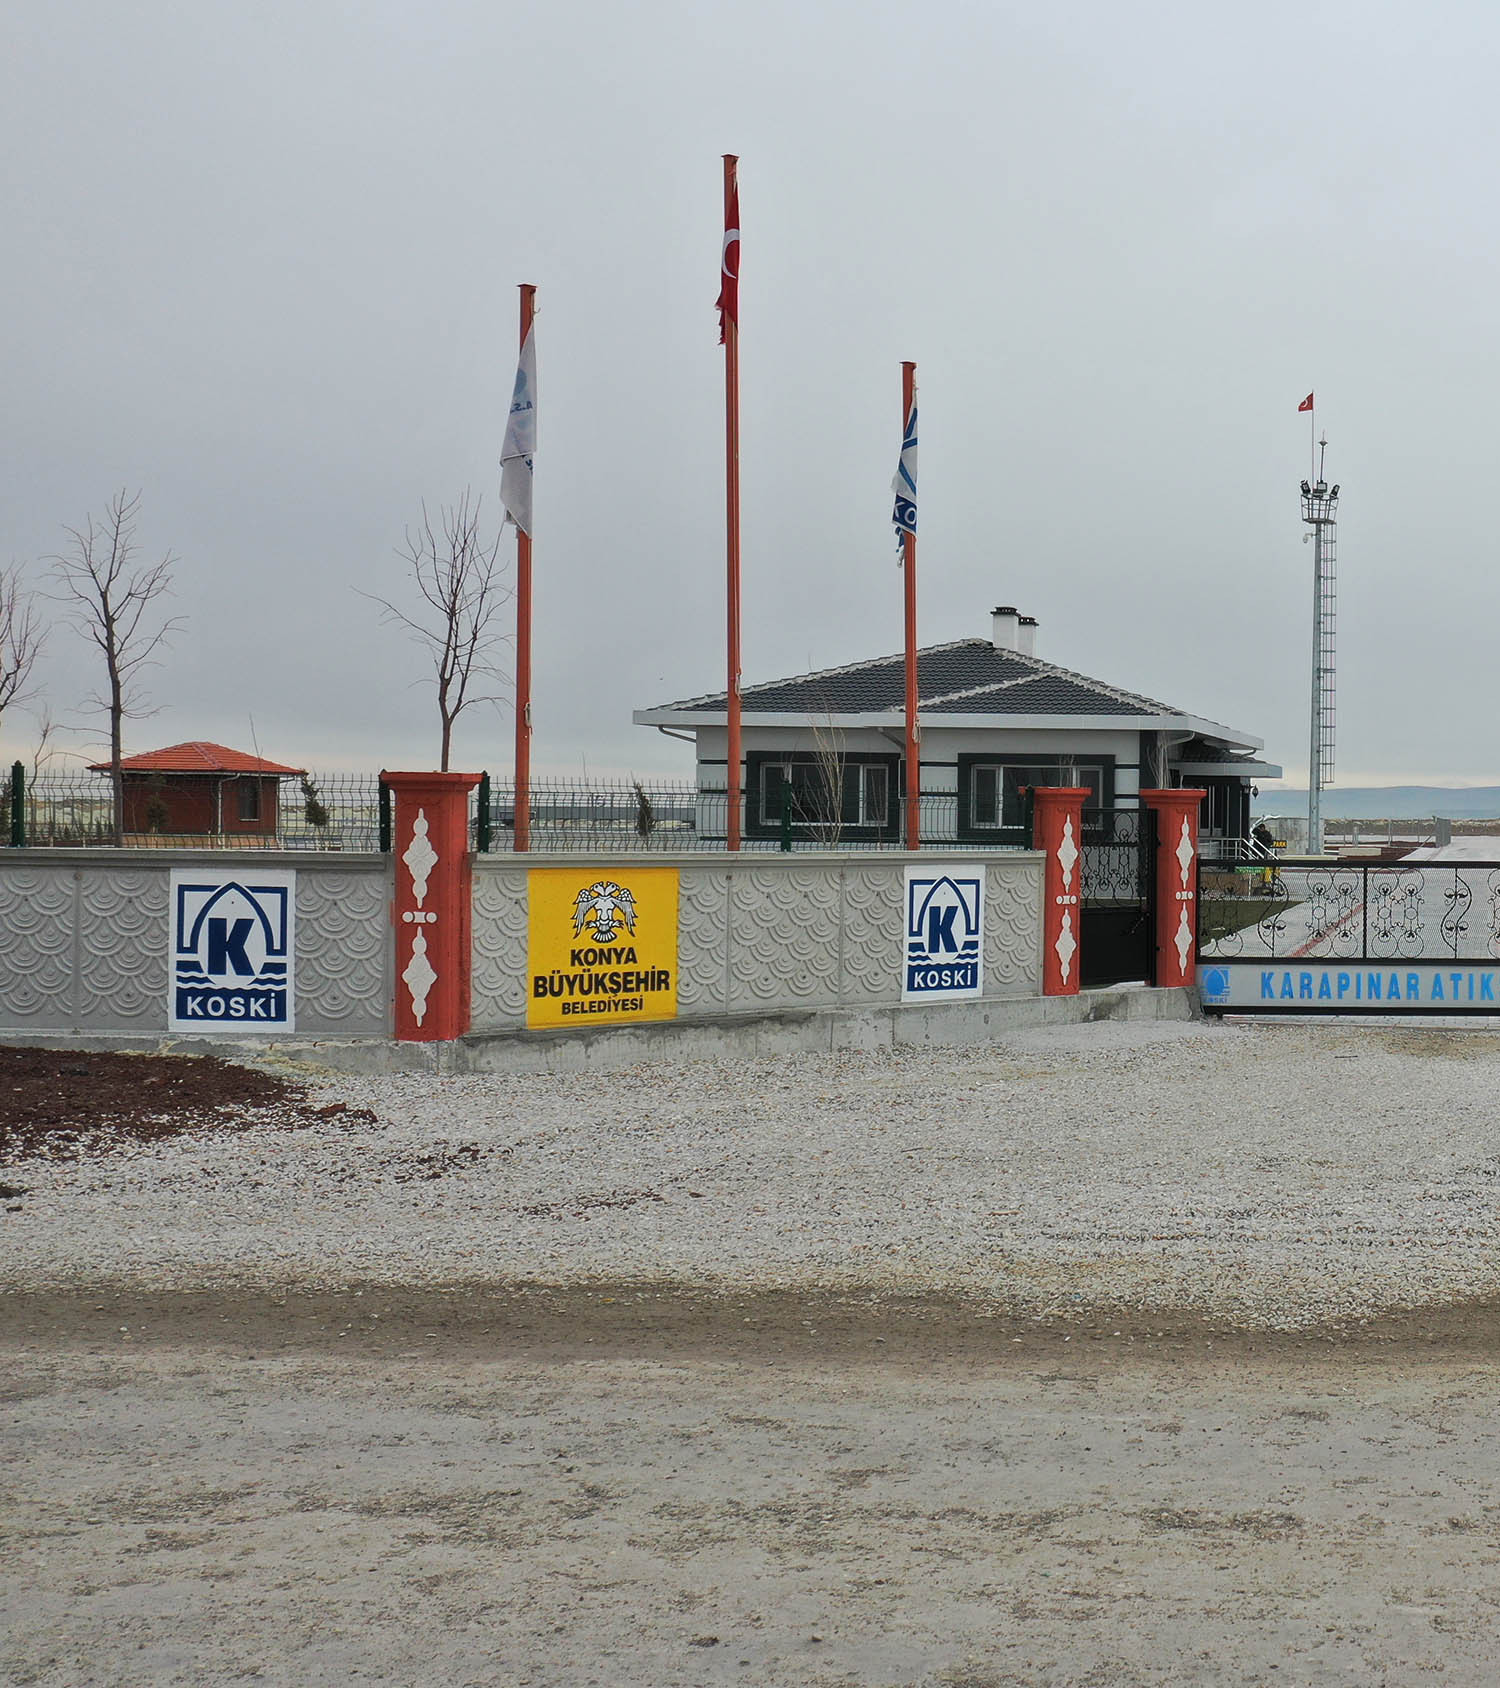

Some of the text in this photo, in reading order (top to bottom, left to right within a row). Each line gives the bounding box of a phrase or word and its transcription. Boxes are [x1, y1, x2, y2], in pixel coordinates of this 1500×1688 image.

[928, 906, 959, 953] K
[208, 918, 255, 976] K
[570, 947, 638, 967] KONYA
[533, 965, 670, 998] BÜYÜKŞEHİR
[914, 965, 971, 988] KOSKİ
[1261, 972, 1419, 1000] KARAPINAR
[186, 992, 276, 1018] KOSKİ
[561, 994, 643, 1015] BELEDİYESİ
